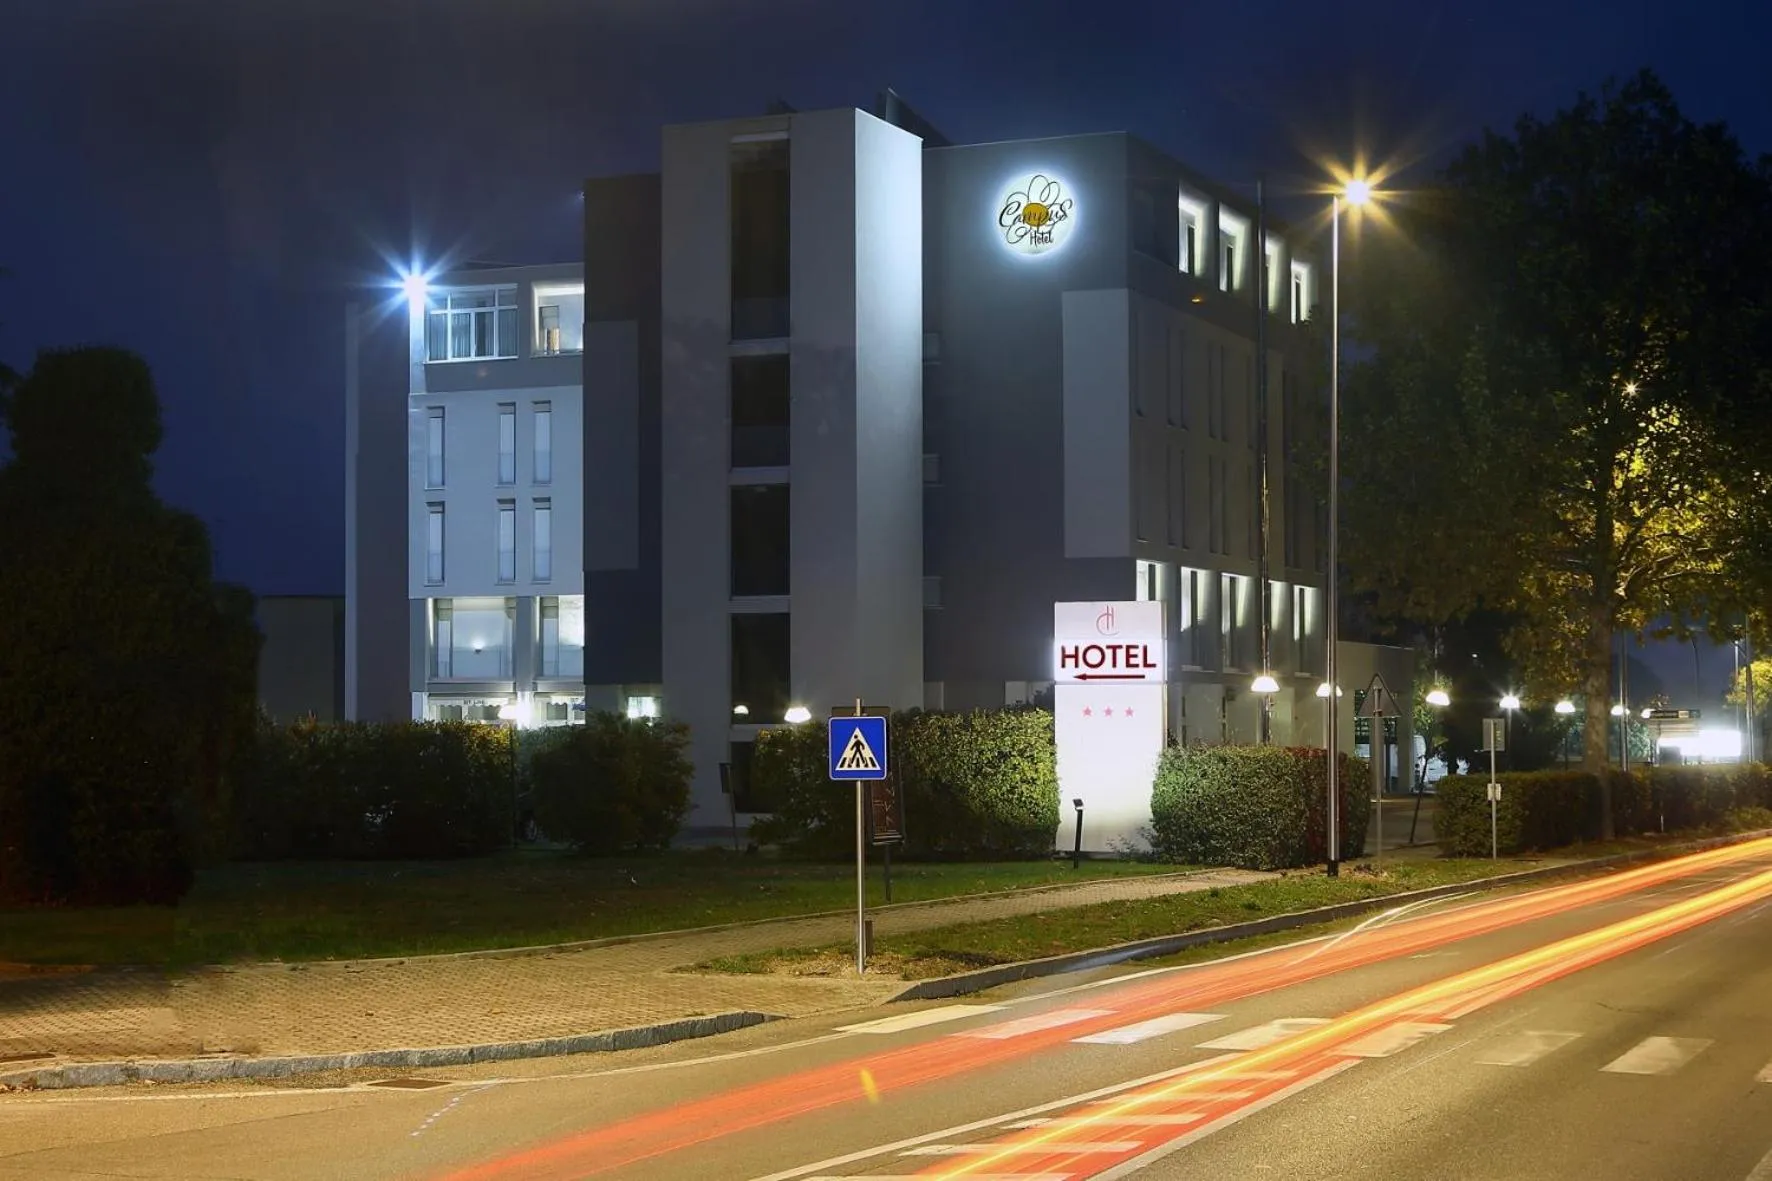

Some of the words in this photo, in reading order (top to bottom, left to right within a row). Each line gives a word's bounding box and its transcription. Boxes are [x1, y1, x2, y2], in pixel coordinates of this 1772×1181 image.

[998, 198, 1073, 231] Campus
[1029, 230, 1054, 247] Hotel
[1061, 644, 1157, 669] HOTEL
